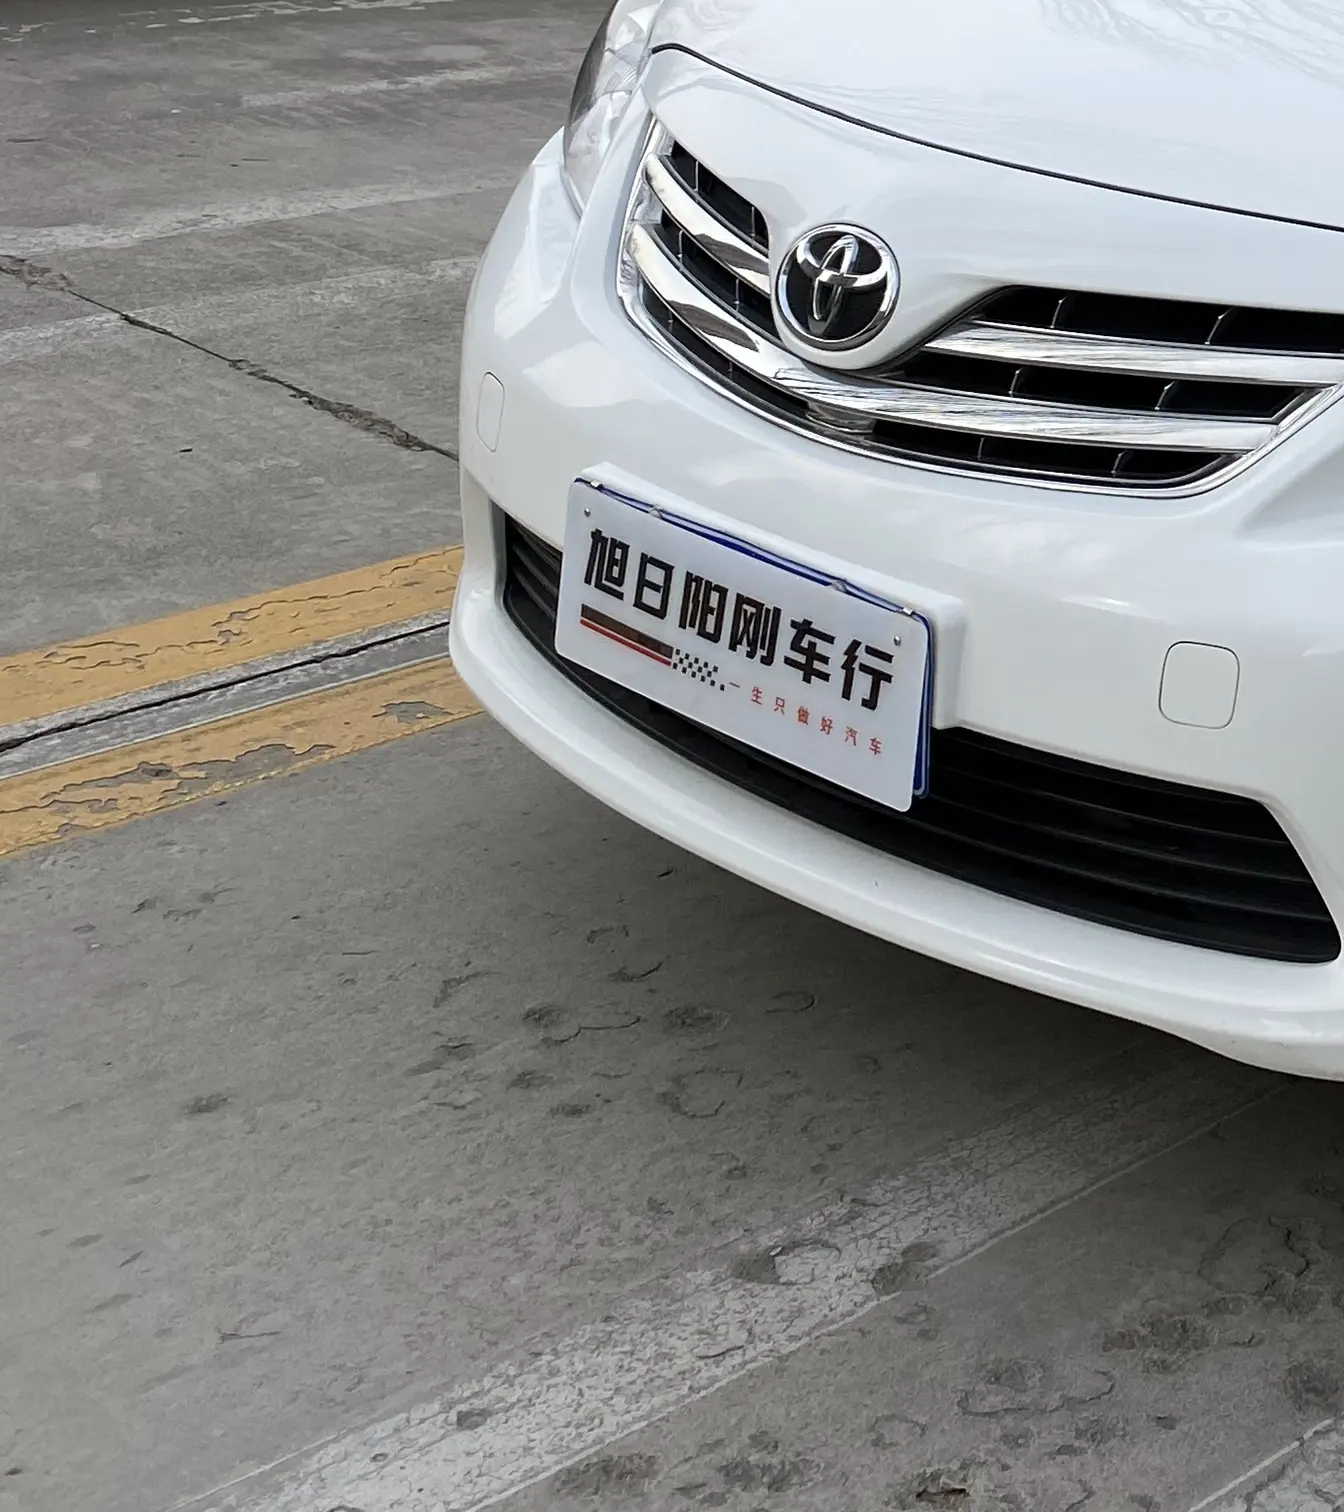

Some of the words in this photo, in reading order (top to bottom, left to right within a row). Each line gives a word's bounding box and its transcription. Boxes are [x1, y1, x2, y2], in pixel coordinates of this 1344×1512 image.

[584, 528, 894, 711] 旭日阳刚车行
[729, 681, 883, 756] 一生只做好汽车
